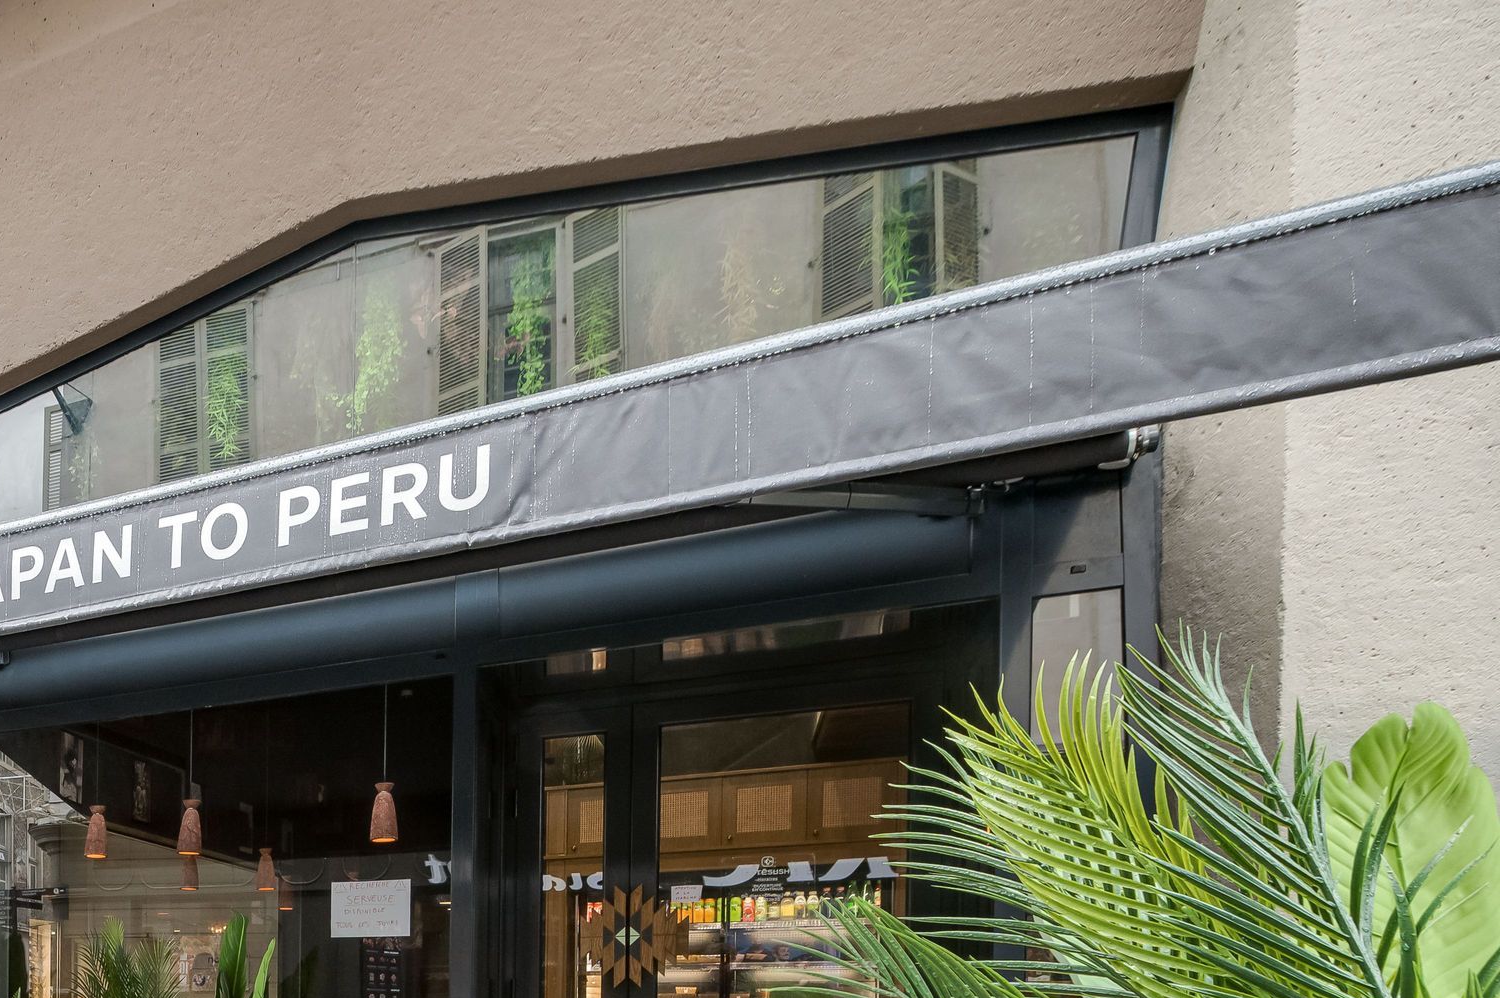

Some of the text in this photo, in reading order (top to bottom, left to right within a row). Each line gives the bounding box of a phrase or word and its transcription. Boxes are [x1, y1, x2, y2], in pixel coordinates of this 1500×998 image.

[159, 502, 249, 570] TO
[278, 444, 491, 548] PERU
[346, 894, 395, 905] SERVEUSE
